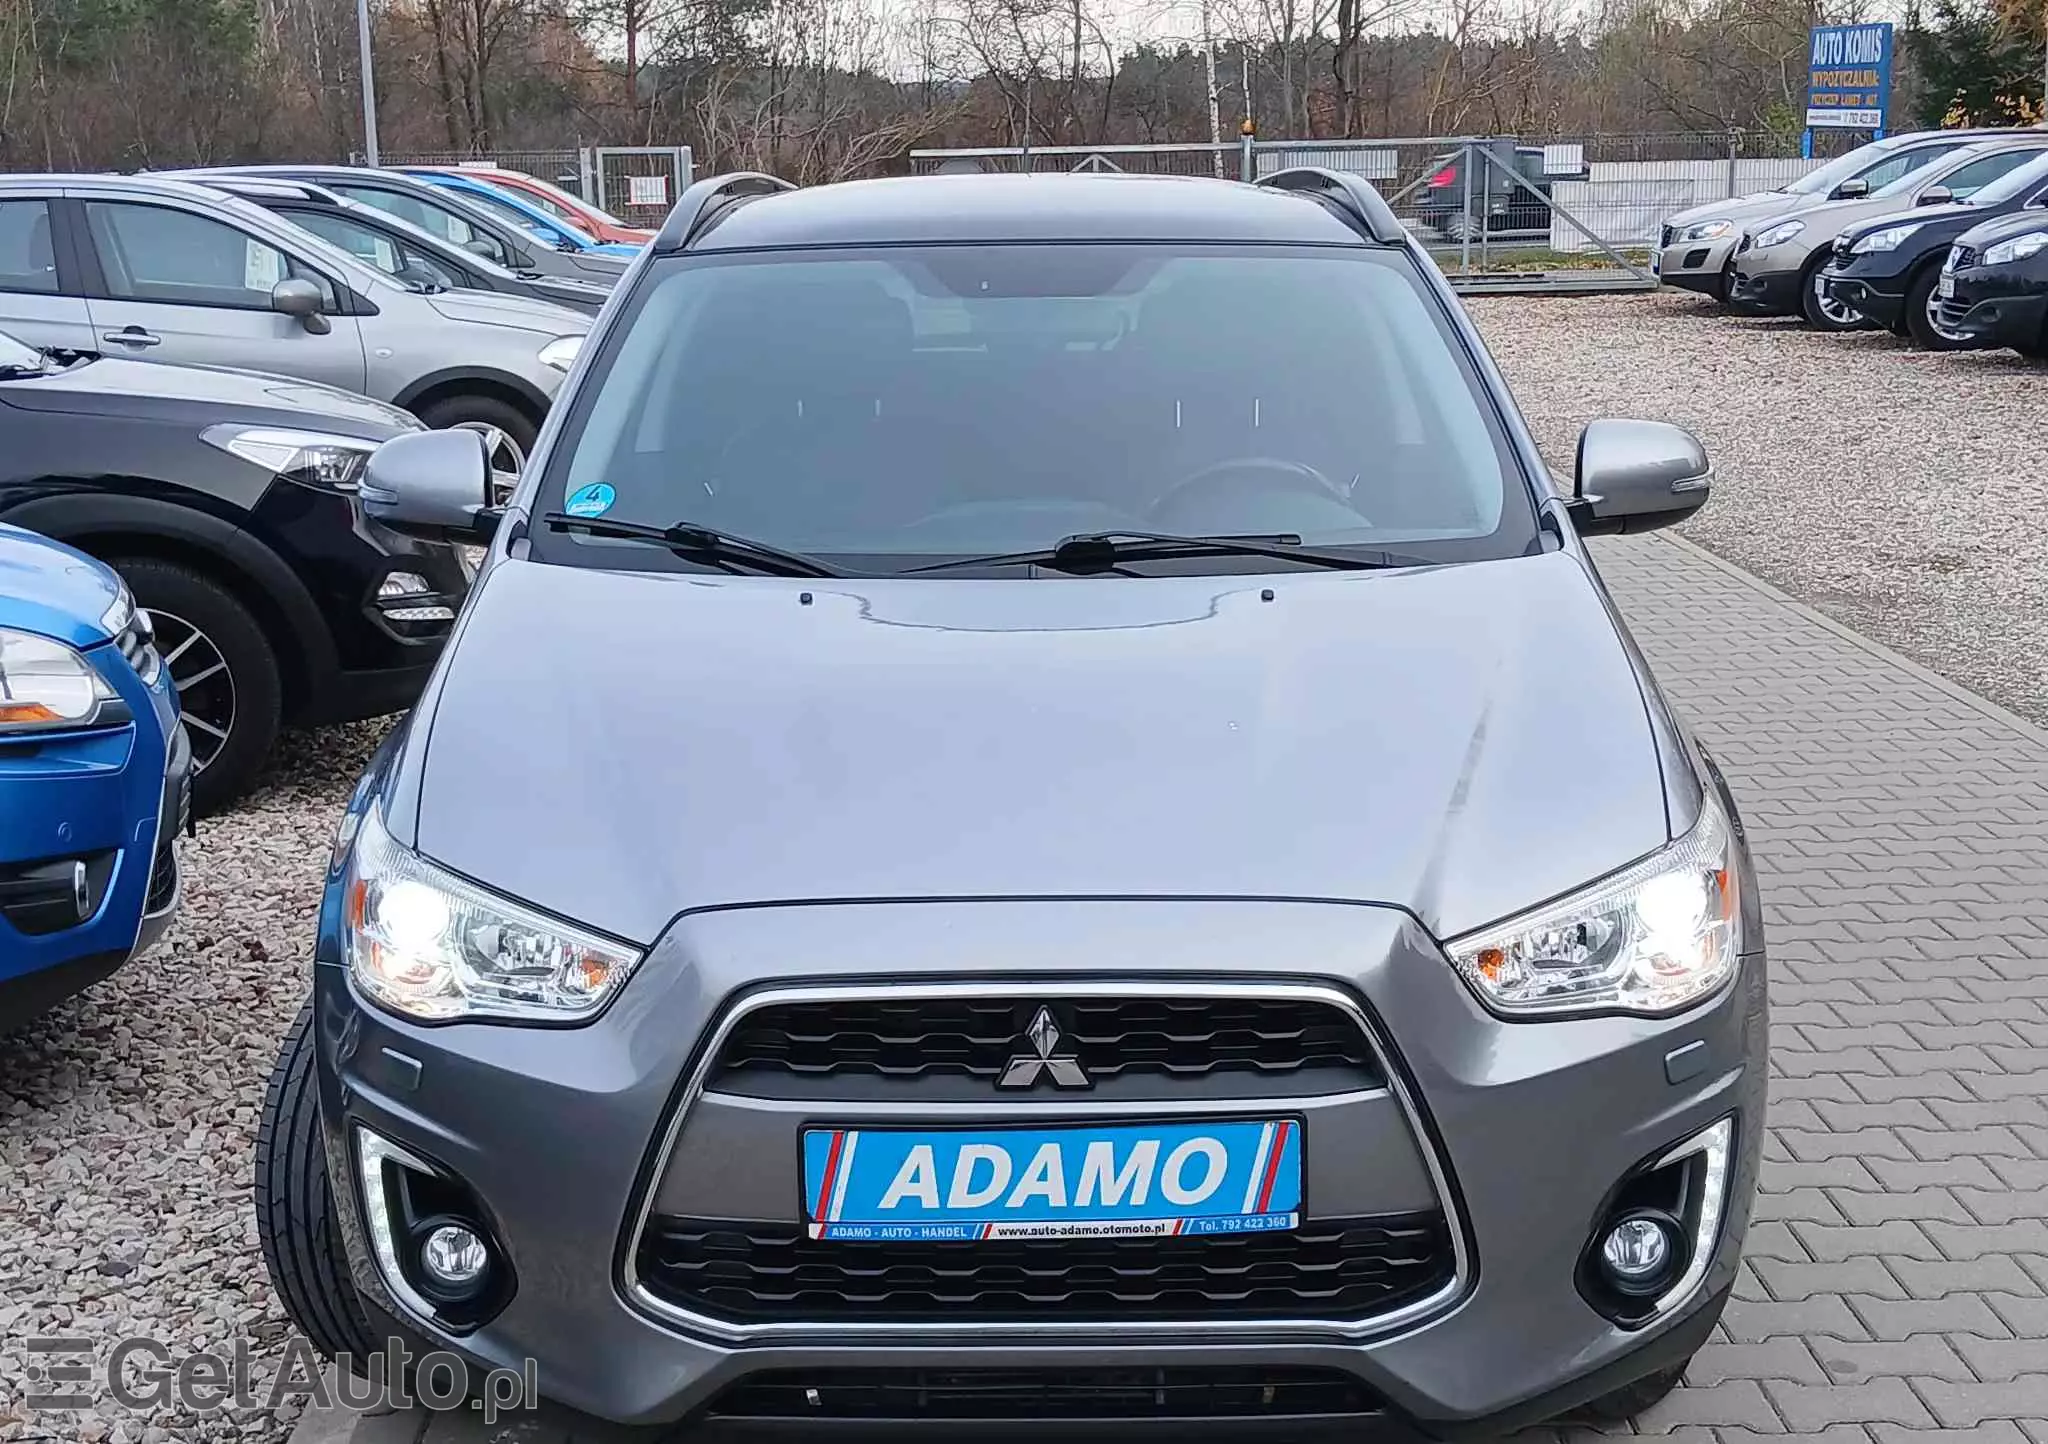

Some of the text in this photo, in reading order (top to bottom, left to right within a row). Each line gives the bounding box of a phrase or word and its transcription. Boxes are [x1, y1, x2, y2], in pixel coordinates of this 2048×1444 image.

[1812, 28, 1883, 65] AUTO KOMIS
[585, 485, 600, 501] 4
[877, 1136, 1228, 1209] ADAMO
[997, 1222, 1165, 1236] www.auto-adamo.otomoto.pl
[1221, 1219, 1240, 1230] 792
[1244, 1217, 1264, 1228] 422
[831, 1226, 872, 1238] ADAMO
[881, 1226, 911, 1238] AUTO
[921, 1225, 967, 1237] HANDEL
